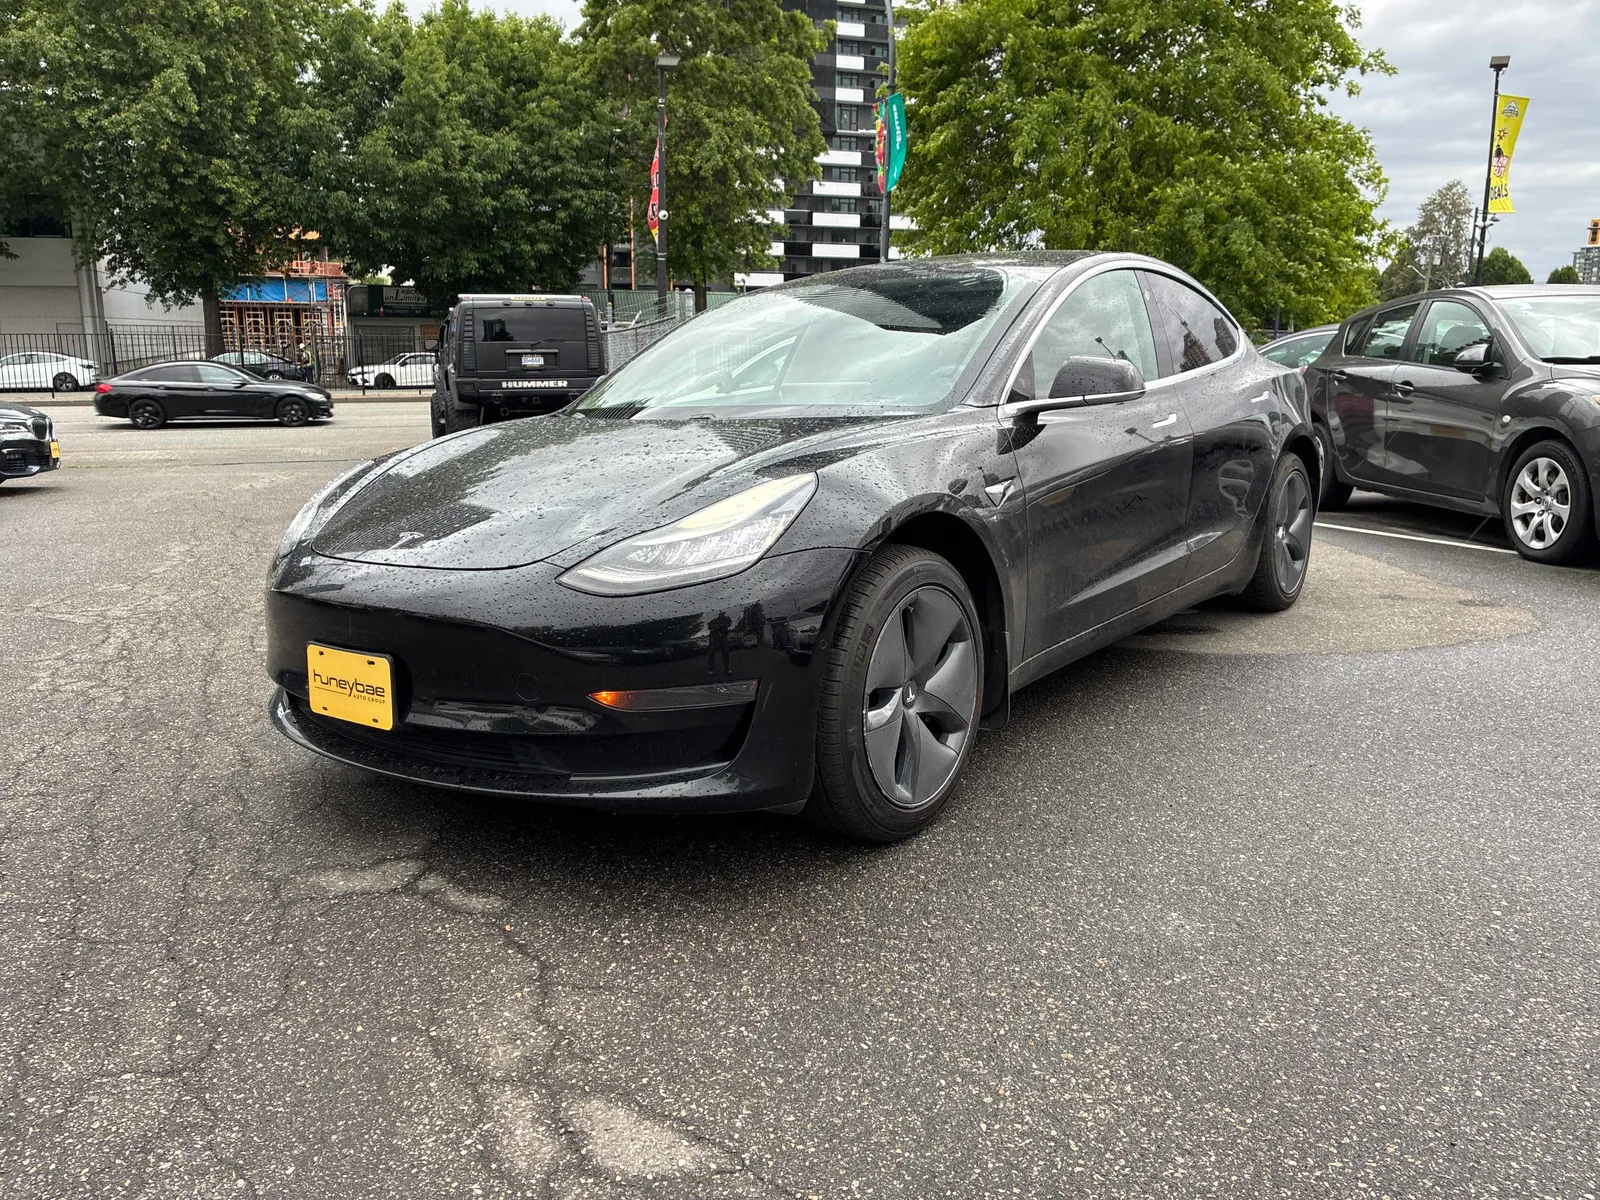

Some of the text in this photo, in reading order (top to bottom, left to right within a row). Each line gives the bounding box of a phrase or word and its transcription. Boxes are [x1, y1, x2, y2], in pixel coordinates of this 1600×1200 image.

[1490, 183, 1508, 200] DEALS
[501, 380, 568, 388] HUMMER
[313, 669, 385, 697] huneybae
[367, 696, 386, 704] GROUP
